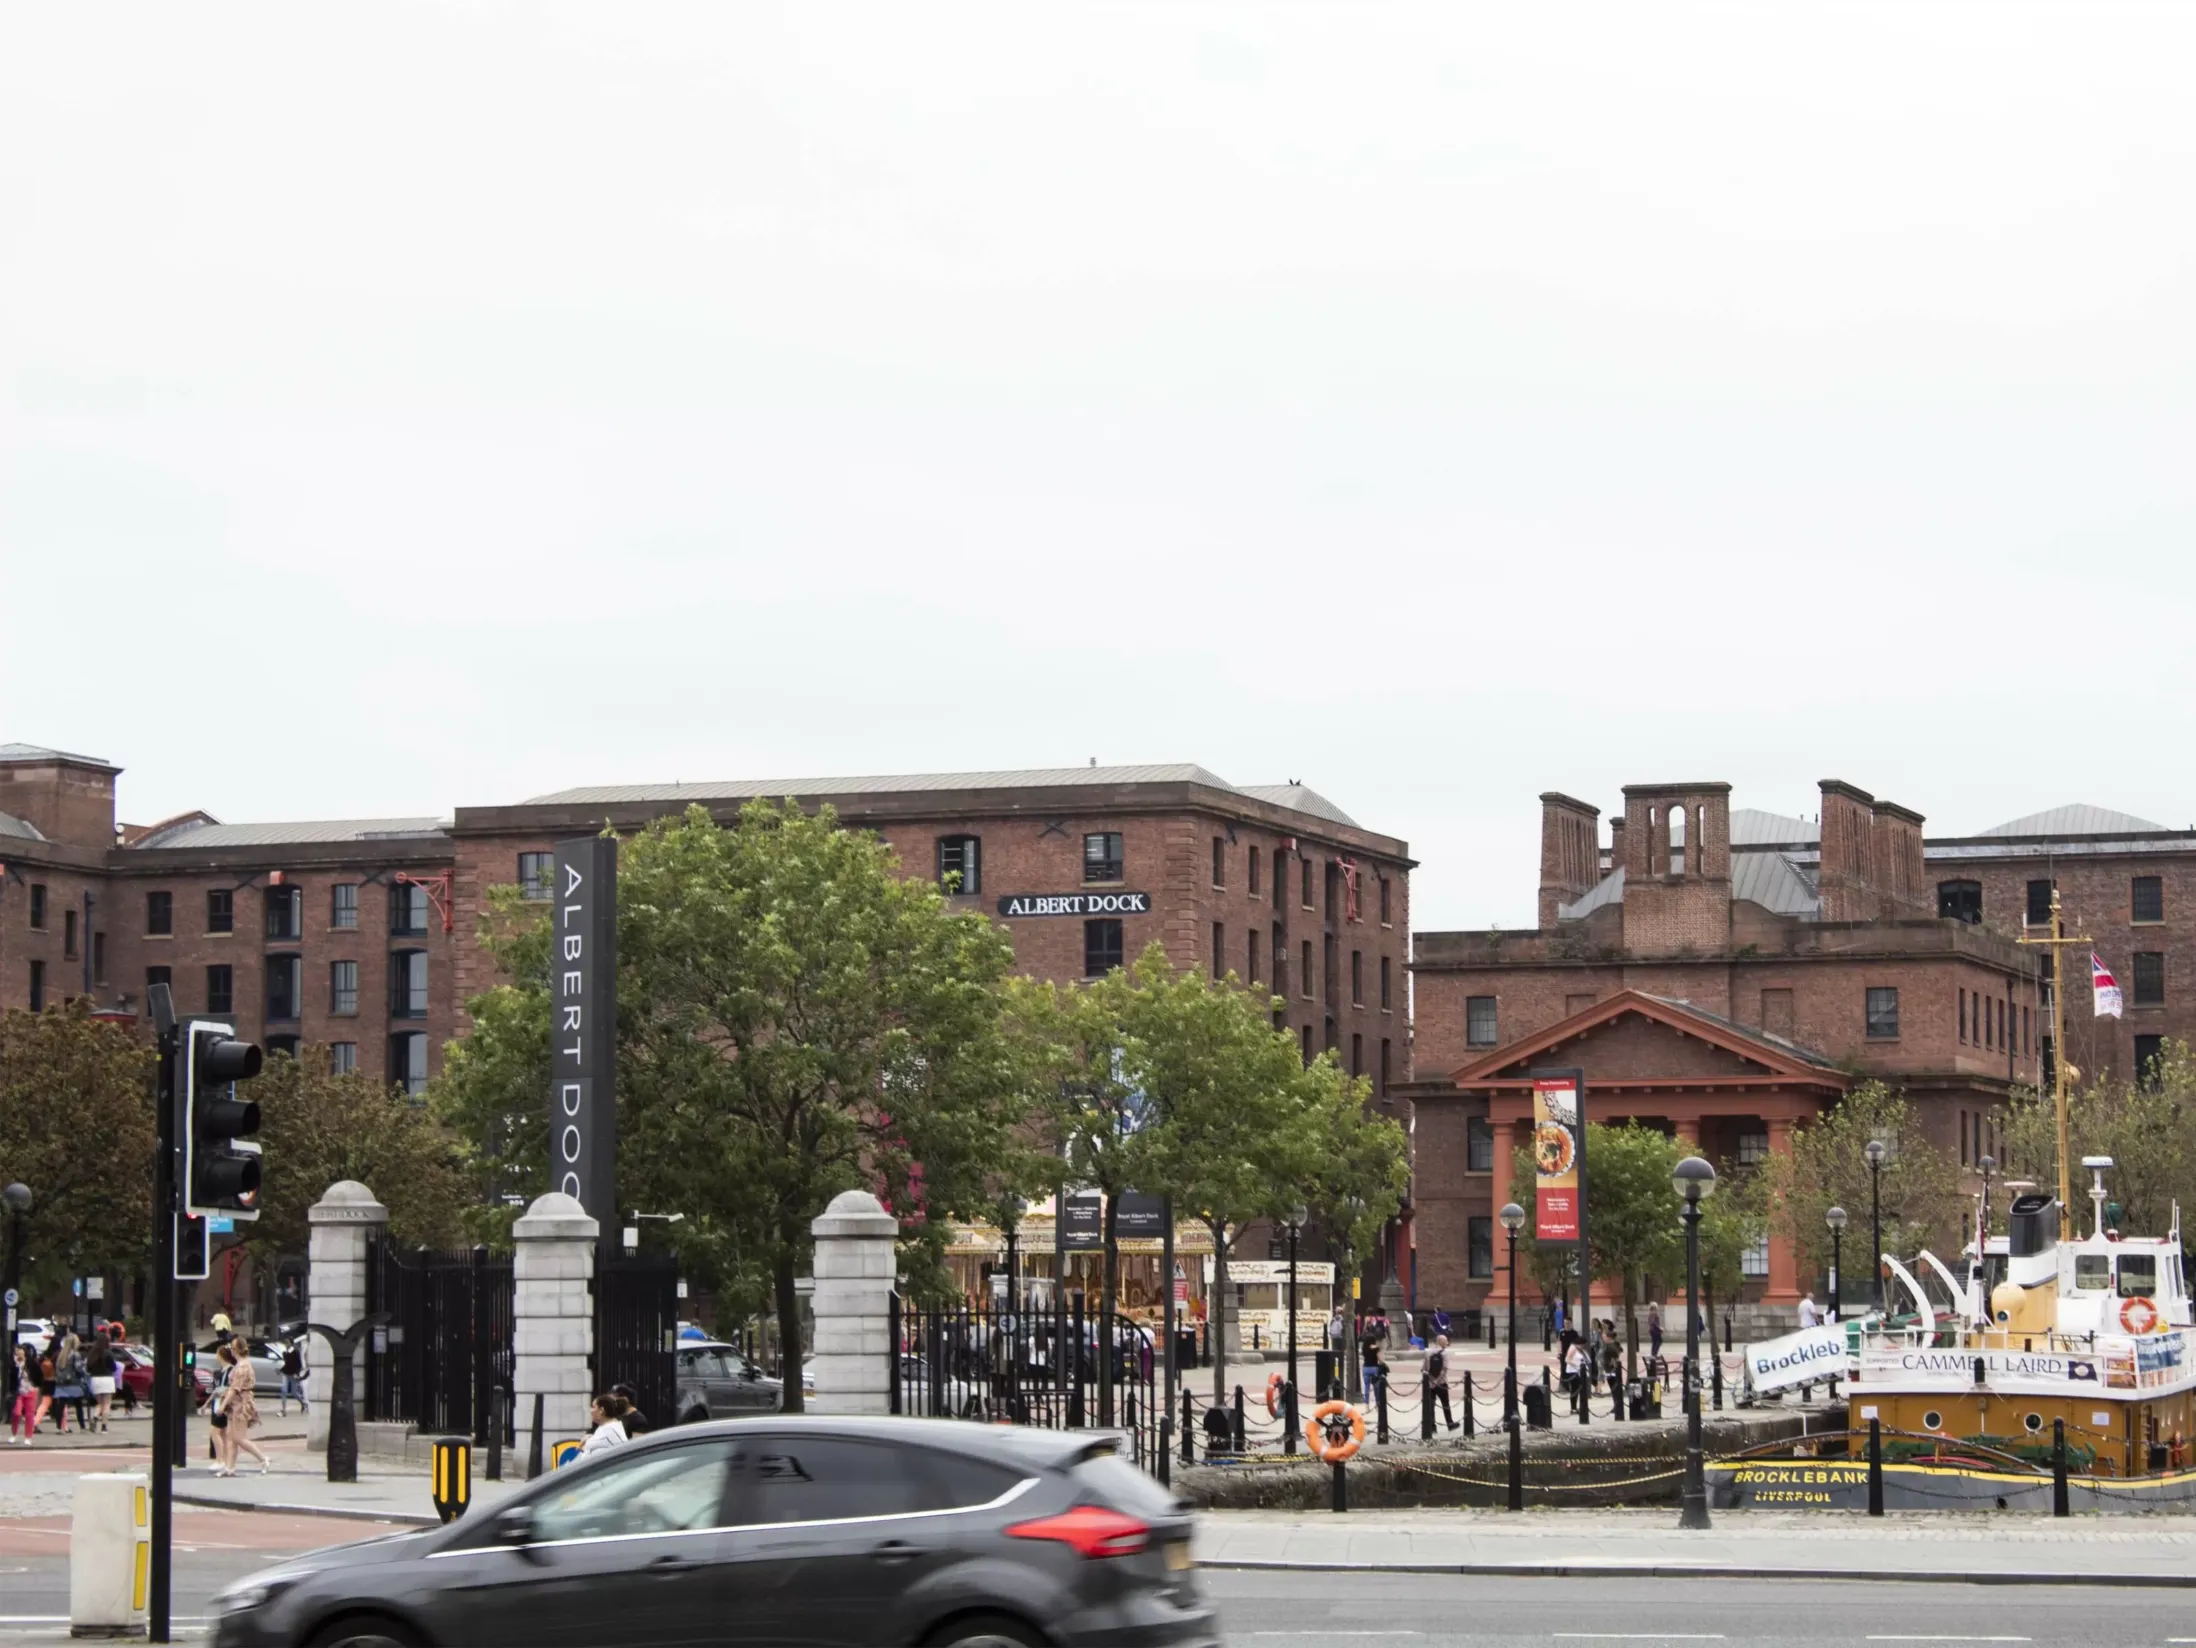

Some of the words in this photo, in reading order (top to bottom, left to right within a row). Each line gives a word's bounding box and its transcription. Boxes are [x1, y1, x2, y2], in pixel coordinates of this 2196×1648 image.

[1007, 896, 1084, 915] ALBERT
[1087, 894, 1146, 912] DOCK
[563, 863, 582, 1065] ALBERT
[562, 1084, 581, 1201] DOC
[1757, 1340, 1844, 1374] Brockleb
[1902, 1354, 2000, 1371] CAMMEL
[2005, 1357, 2062, 1374] LAIRD
[1734, 1470, 1868, 1484] BROCKLEBANK
[1755, 1490, 1832, 1502] LIVERPOOL
